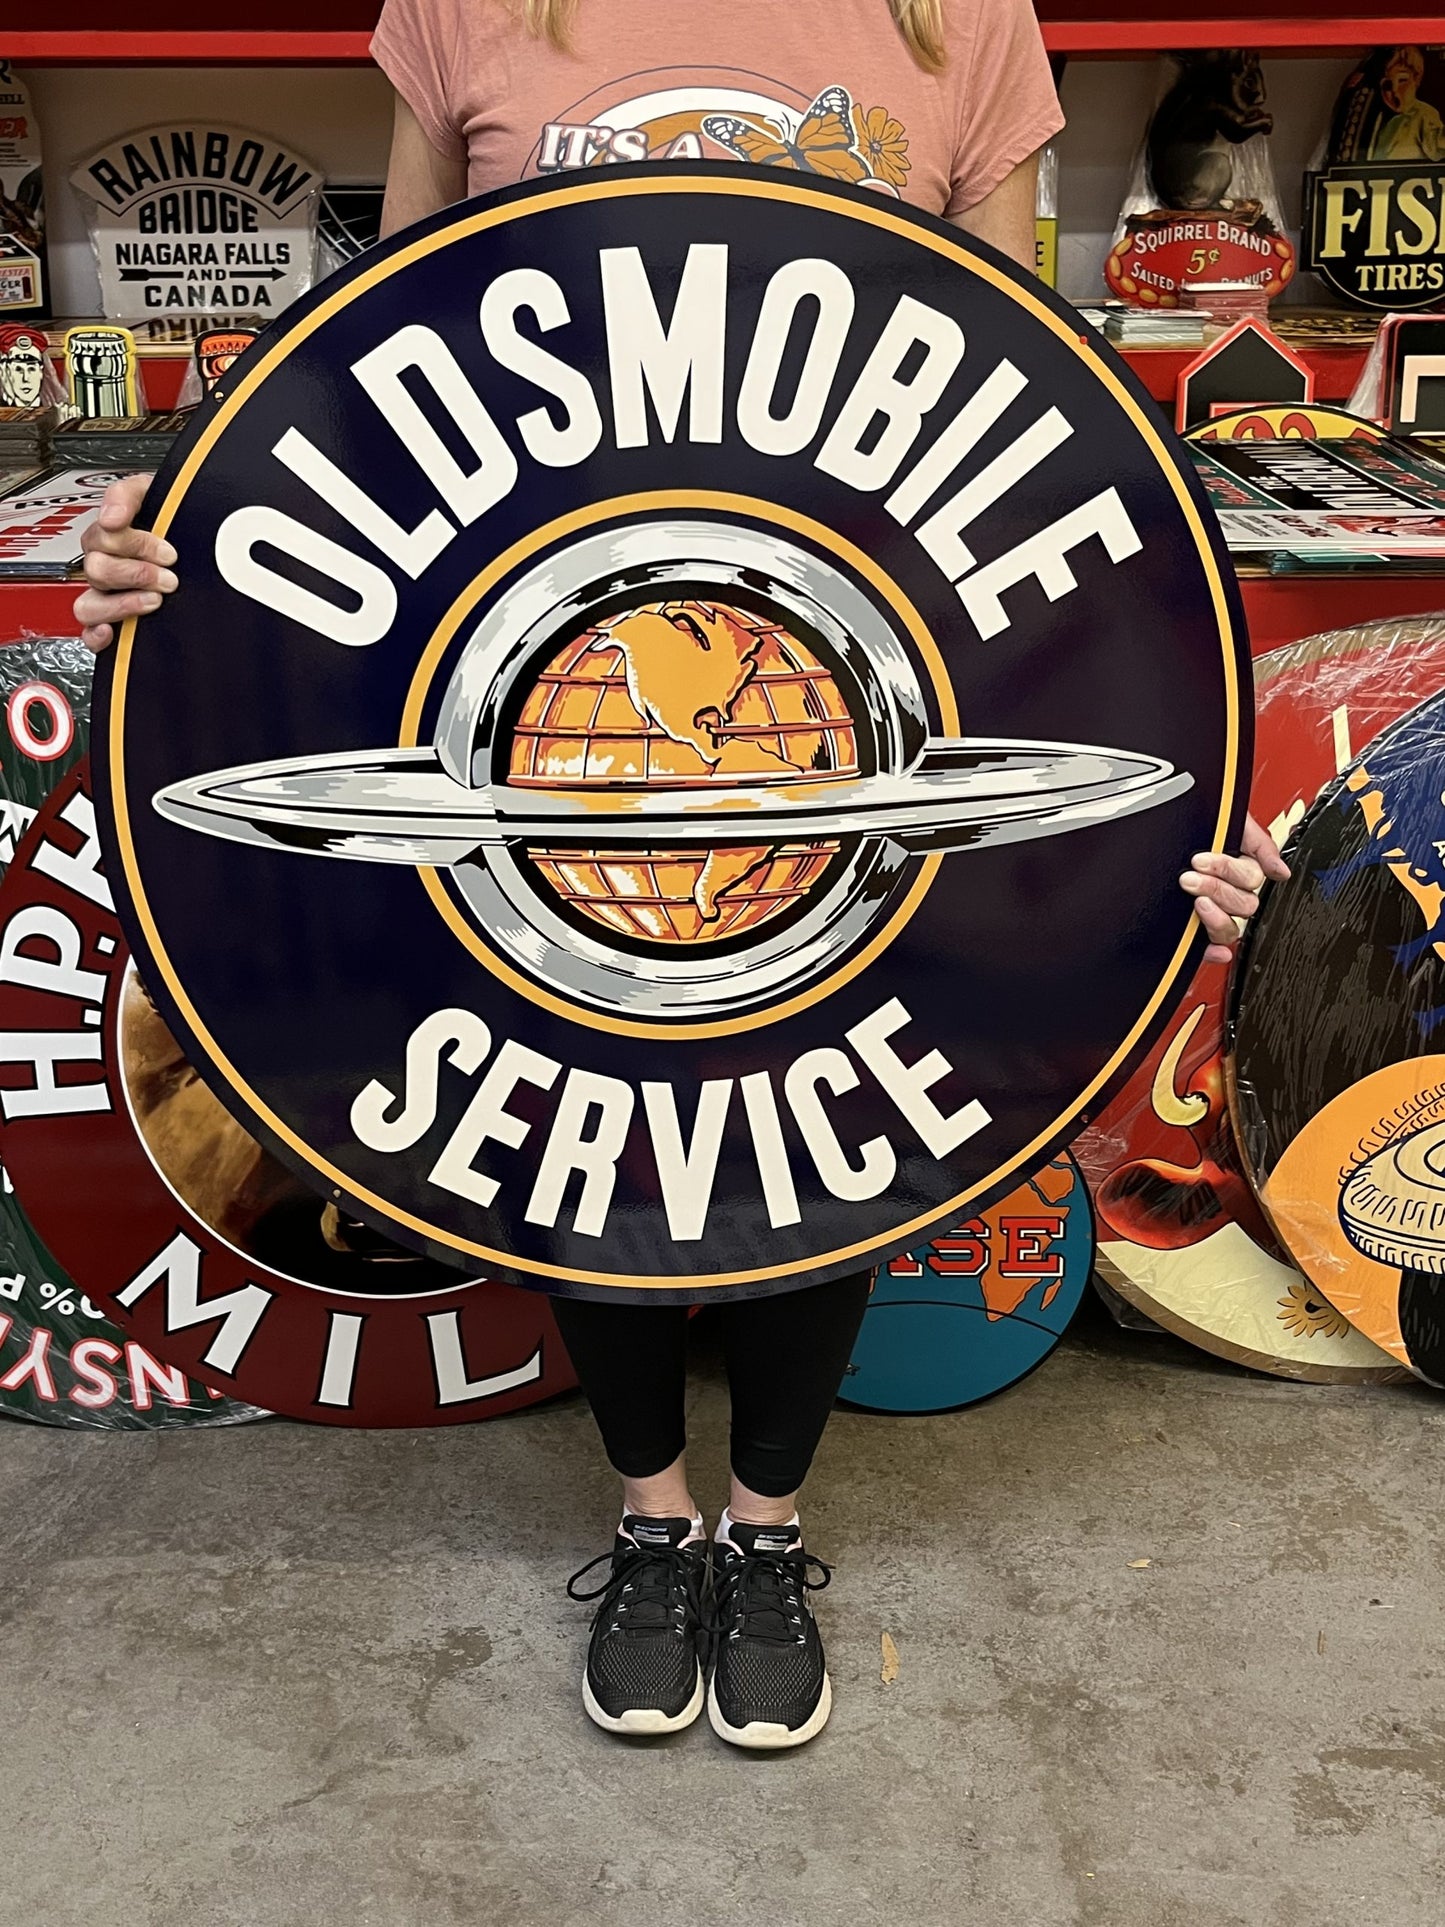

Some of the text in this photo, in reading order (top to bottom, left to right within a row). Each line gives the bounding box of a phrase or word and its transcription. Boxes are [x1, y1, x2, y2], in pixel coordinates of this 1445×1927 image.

[537, 123, 703, 169] IT'S A
[88, 131, 312, 206] RAINBOW
[139, 190, 259, 234] BRIDGE
[115, 242, 290, 265] NIAGARA FALLS
[1134, 220, 1272, 257] SQUIRREL BRAND
[187, 269, 227, 281] AND
[1130, 261, 1273, 292] SALTED NUTS
[1355, 262, 1444, 292] TIRES
[144, 284, 272, 307] CANADA
[215, 243, 1144, 646] OLDSMOBILE
[350, 996, 993, 1241] SERVICE
[114, 1229, 542, 1408] MIL
